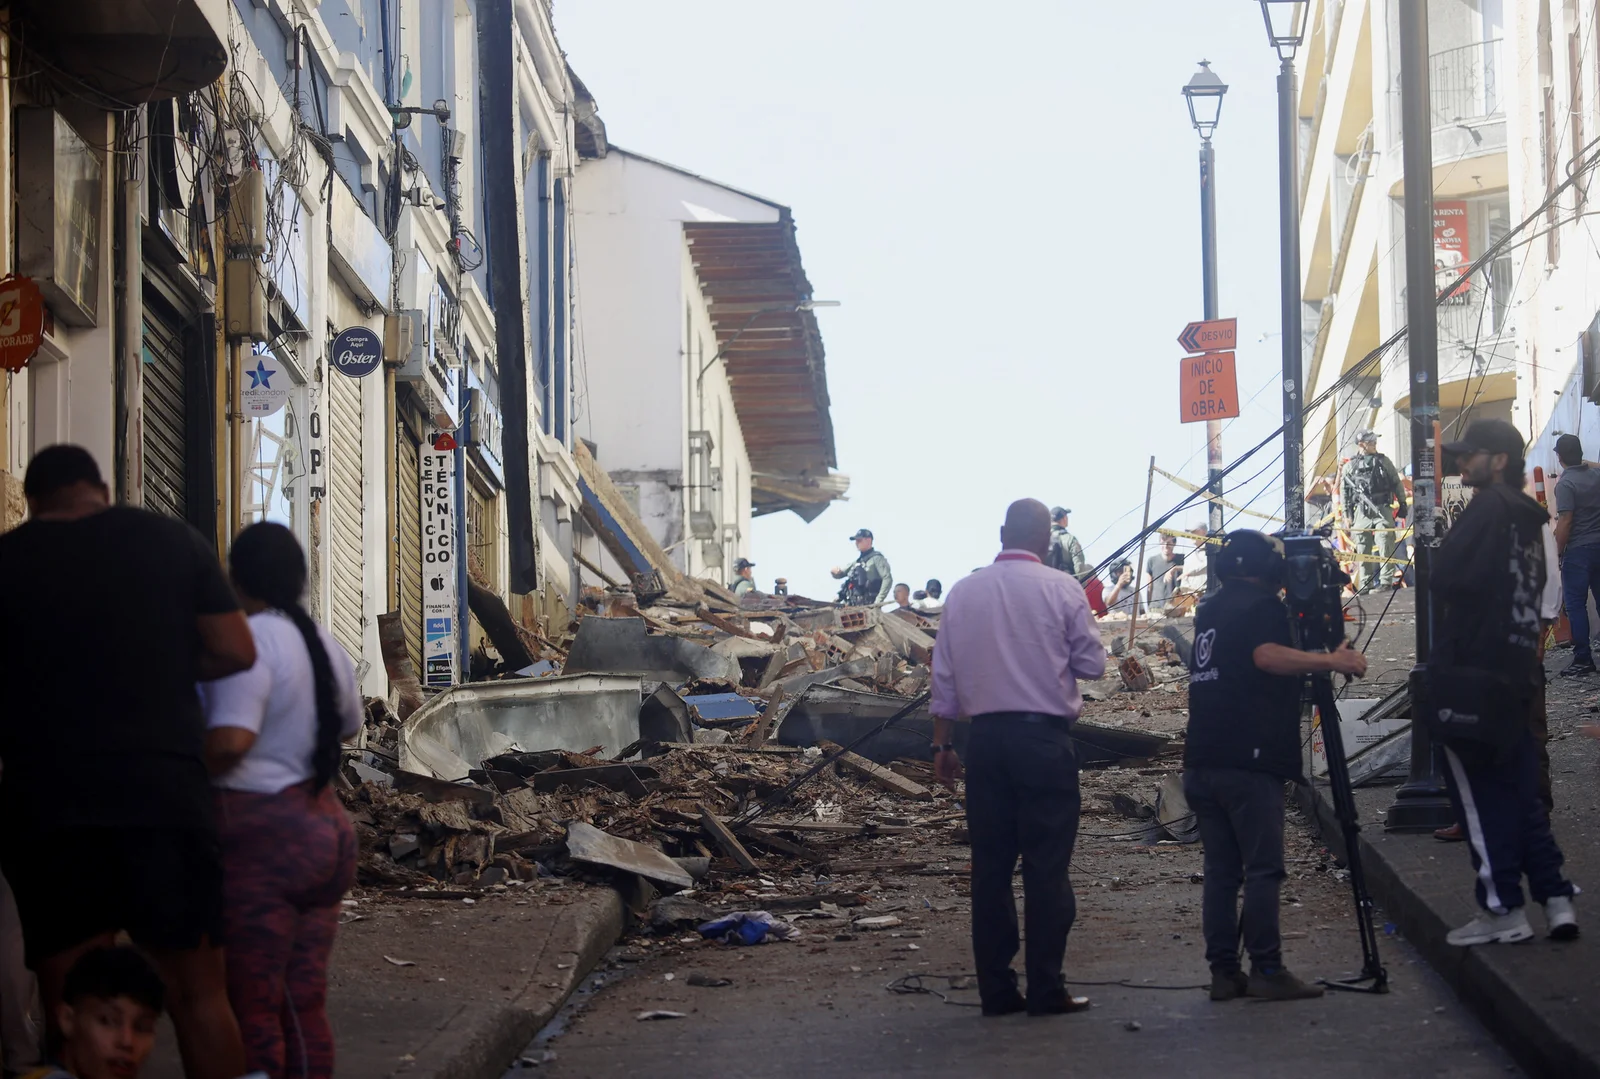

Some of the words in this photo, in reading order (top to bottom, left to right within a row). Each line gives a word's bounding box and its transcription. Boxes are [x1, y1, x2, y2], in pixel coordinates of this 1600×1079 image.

[1439, 208, 1464, 216] RENTA
[1433, 219, 1446, 228] QUI
[1201, 329, 1233, 342] DESVIO
[338, 349, 377, 366] Oster
[1191, 358, 1223, 377] INICIO
[1199, 379, 1215, 395] DE
[1191, 398, 1227, 416] OBRA
[423, 455, 437, 564] SERVICIO
[436, 455, 450, 563] TÉCNICO
